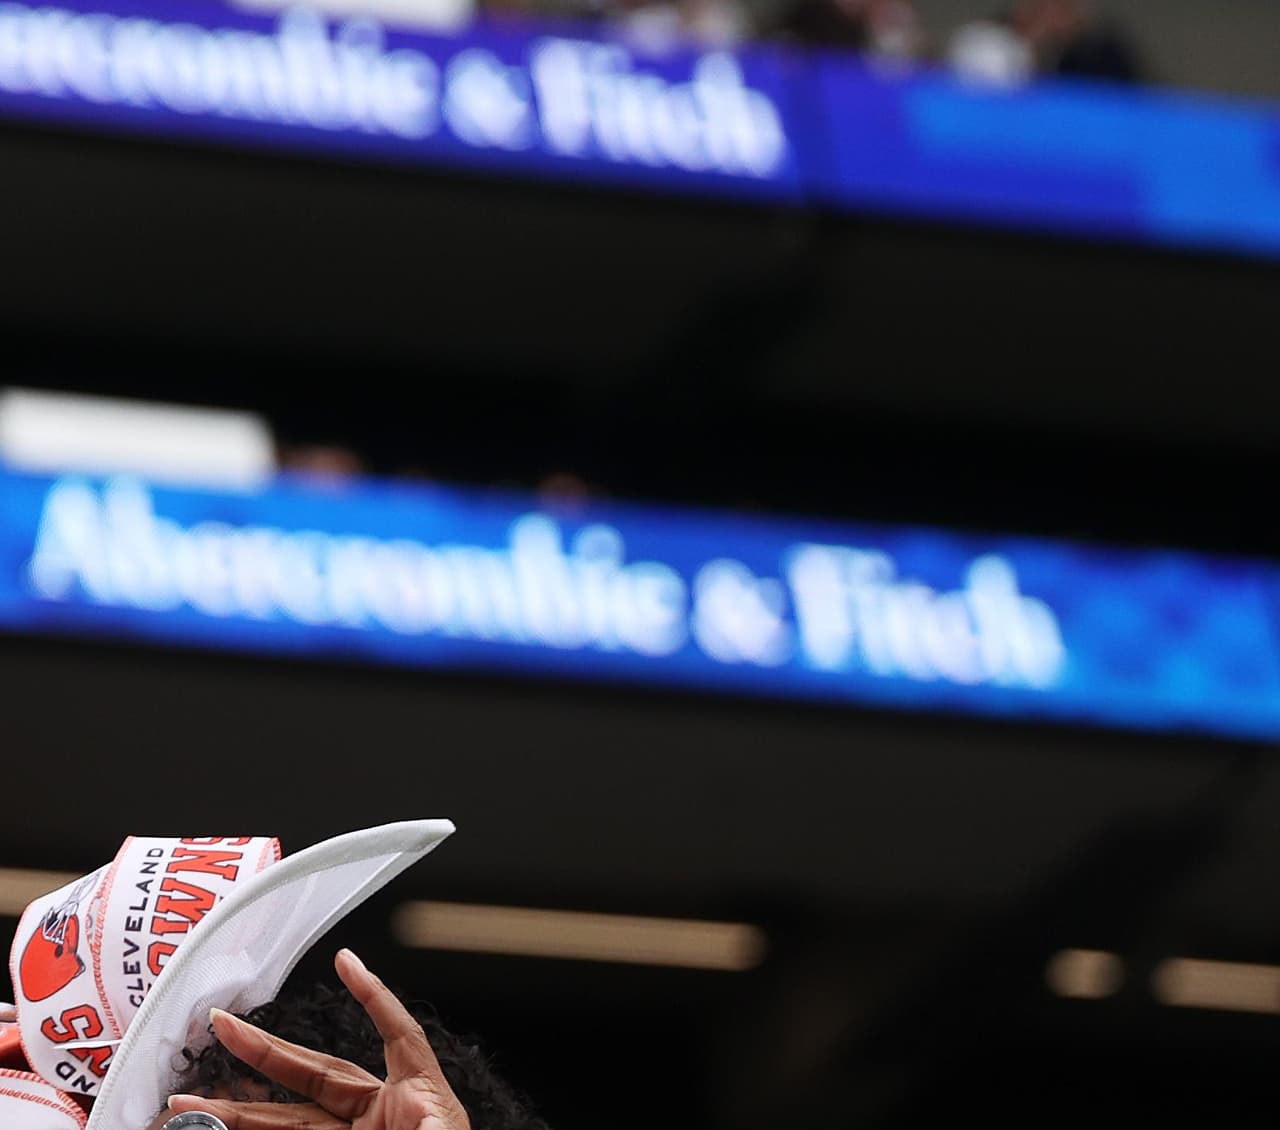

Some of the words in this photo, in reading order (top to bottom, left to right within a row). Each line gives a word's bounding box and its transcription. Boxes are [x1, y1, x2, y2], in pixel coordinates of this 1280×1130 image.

[30, 473, 687, 658] Abercrombie
[782, 541, 1067, 691] Fitch
[122, 847, 164, 1009] CLEVELAND
